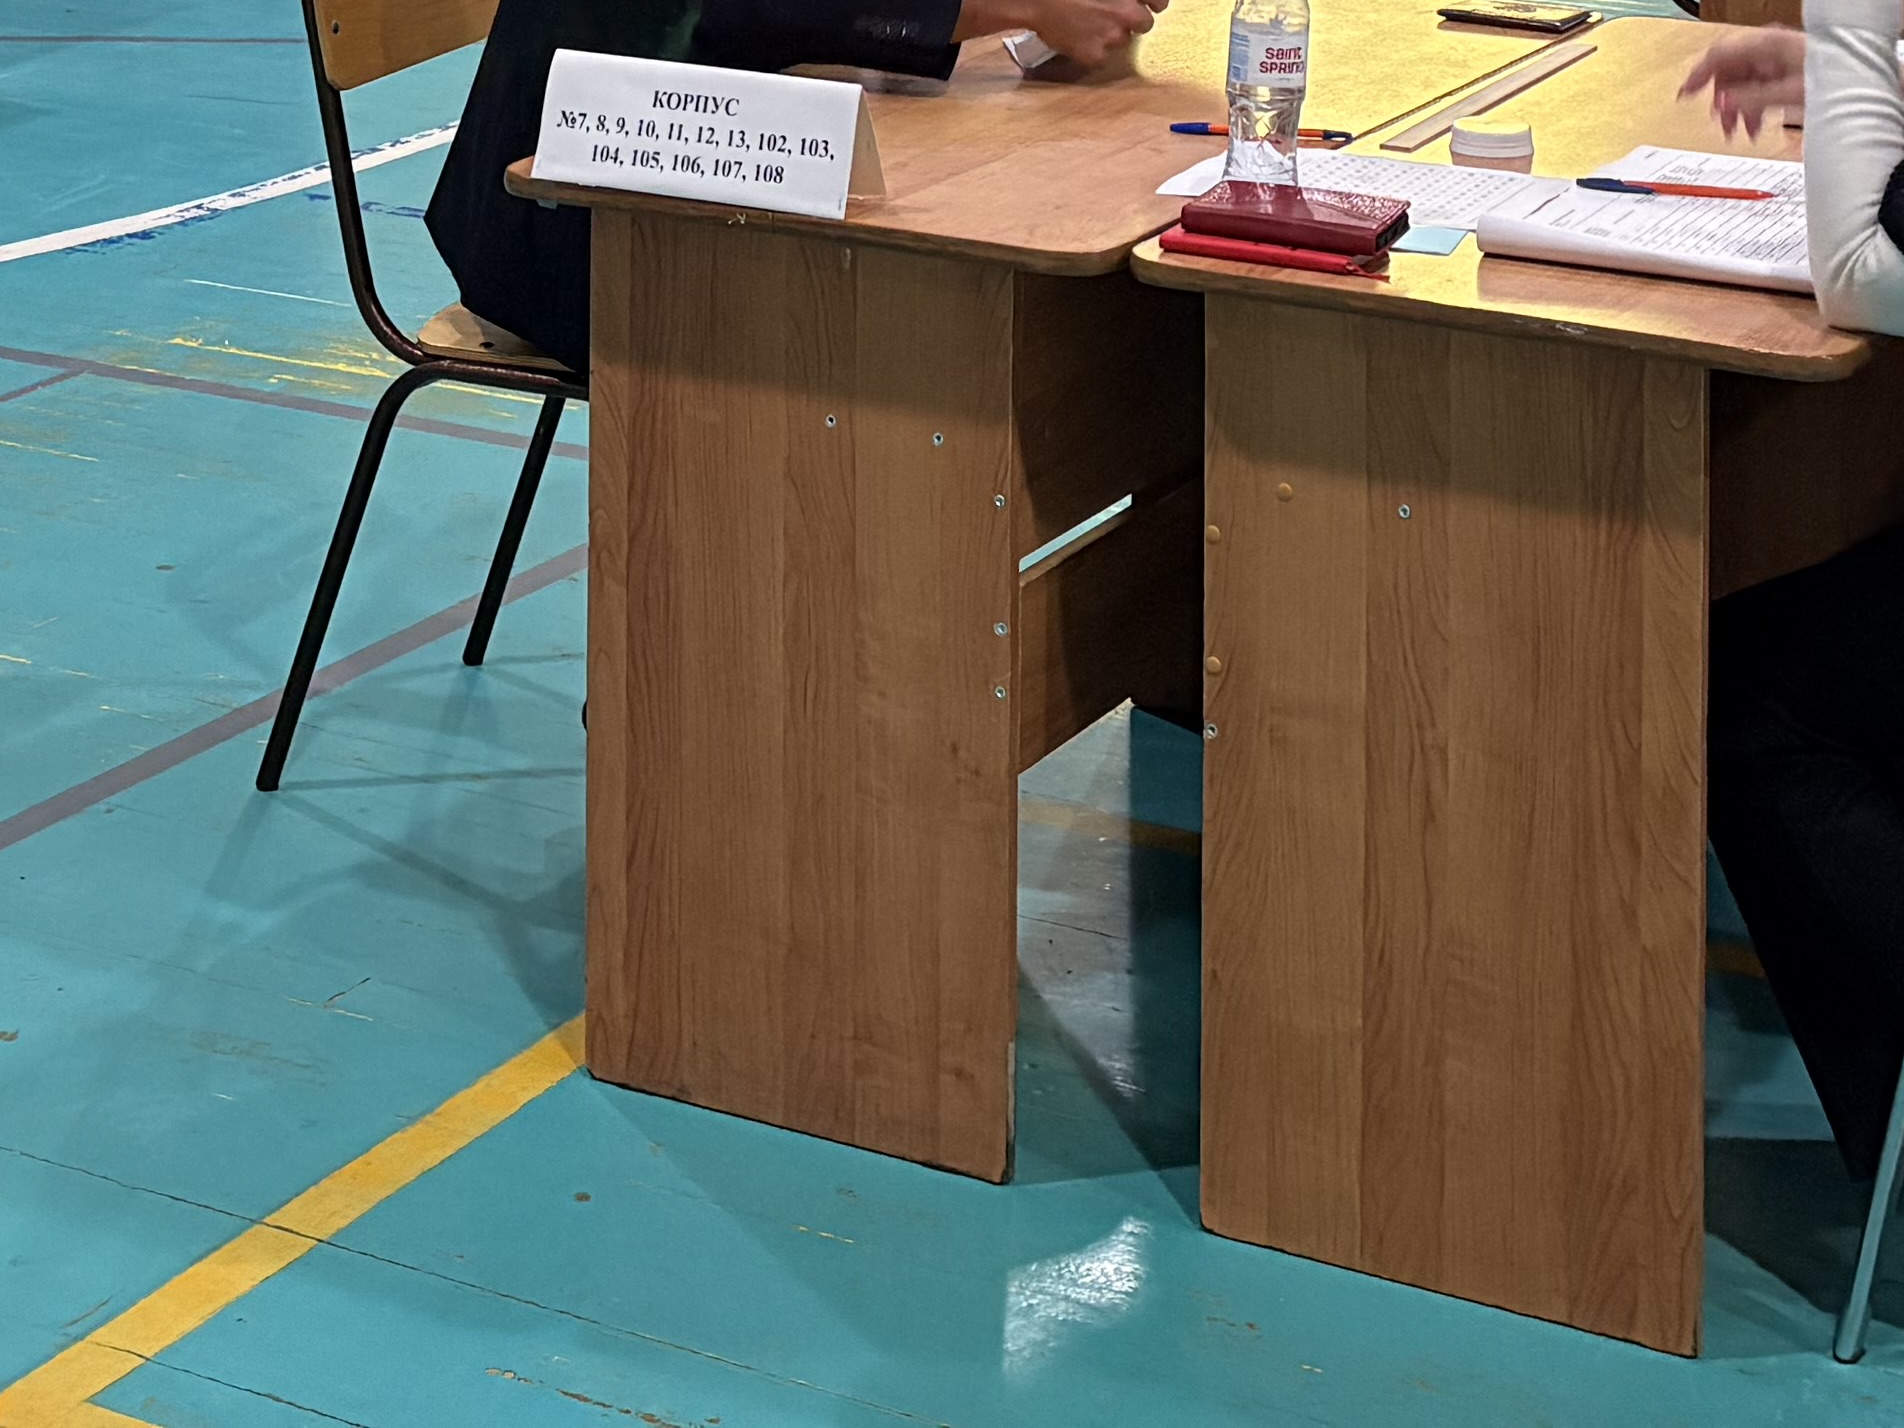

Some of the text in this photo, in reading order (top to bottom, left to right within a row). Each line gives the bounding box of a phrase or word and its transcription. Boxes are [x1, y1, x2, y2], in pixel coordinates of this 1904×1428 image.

[652, 89, 740, 117] КОРПУС
[557, 110, 835, 162] №7, 8, 9, 10, 11, 12, 13, 102, 103,
[591, 144, 785, 184] 104, 105, 106, 107, 108
